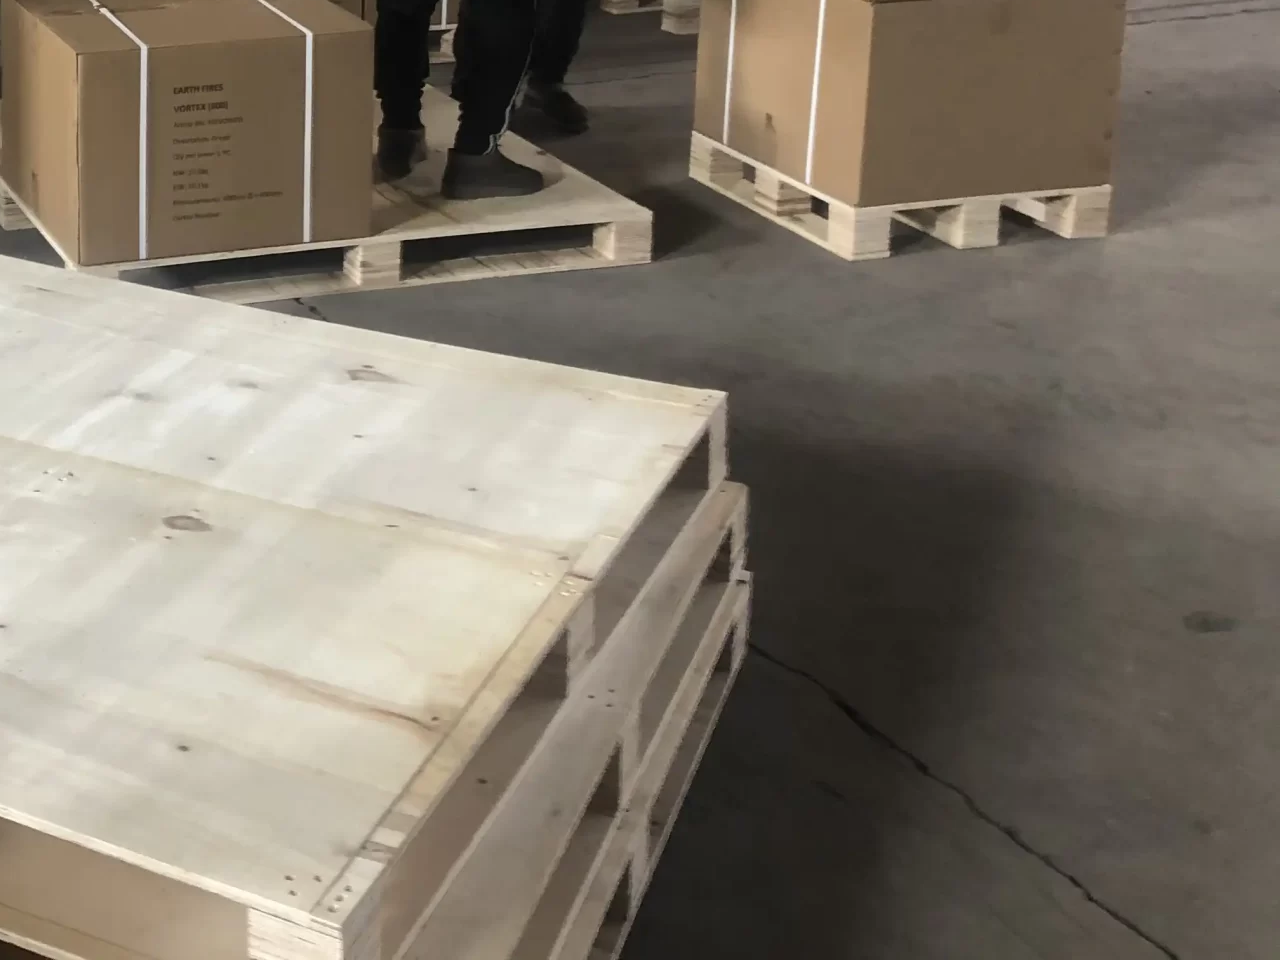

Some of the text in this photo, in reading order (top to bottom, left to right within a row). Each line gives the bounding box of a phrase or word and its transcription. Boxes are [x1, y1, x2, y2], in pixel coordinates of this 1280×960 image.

[173, 84, 224, 95] EARTH FIRES
[174, 103, 206, 113] VORTEX
